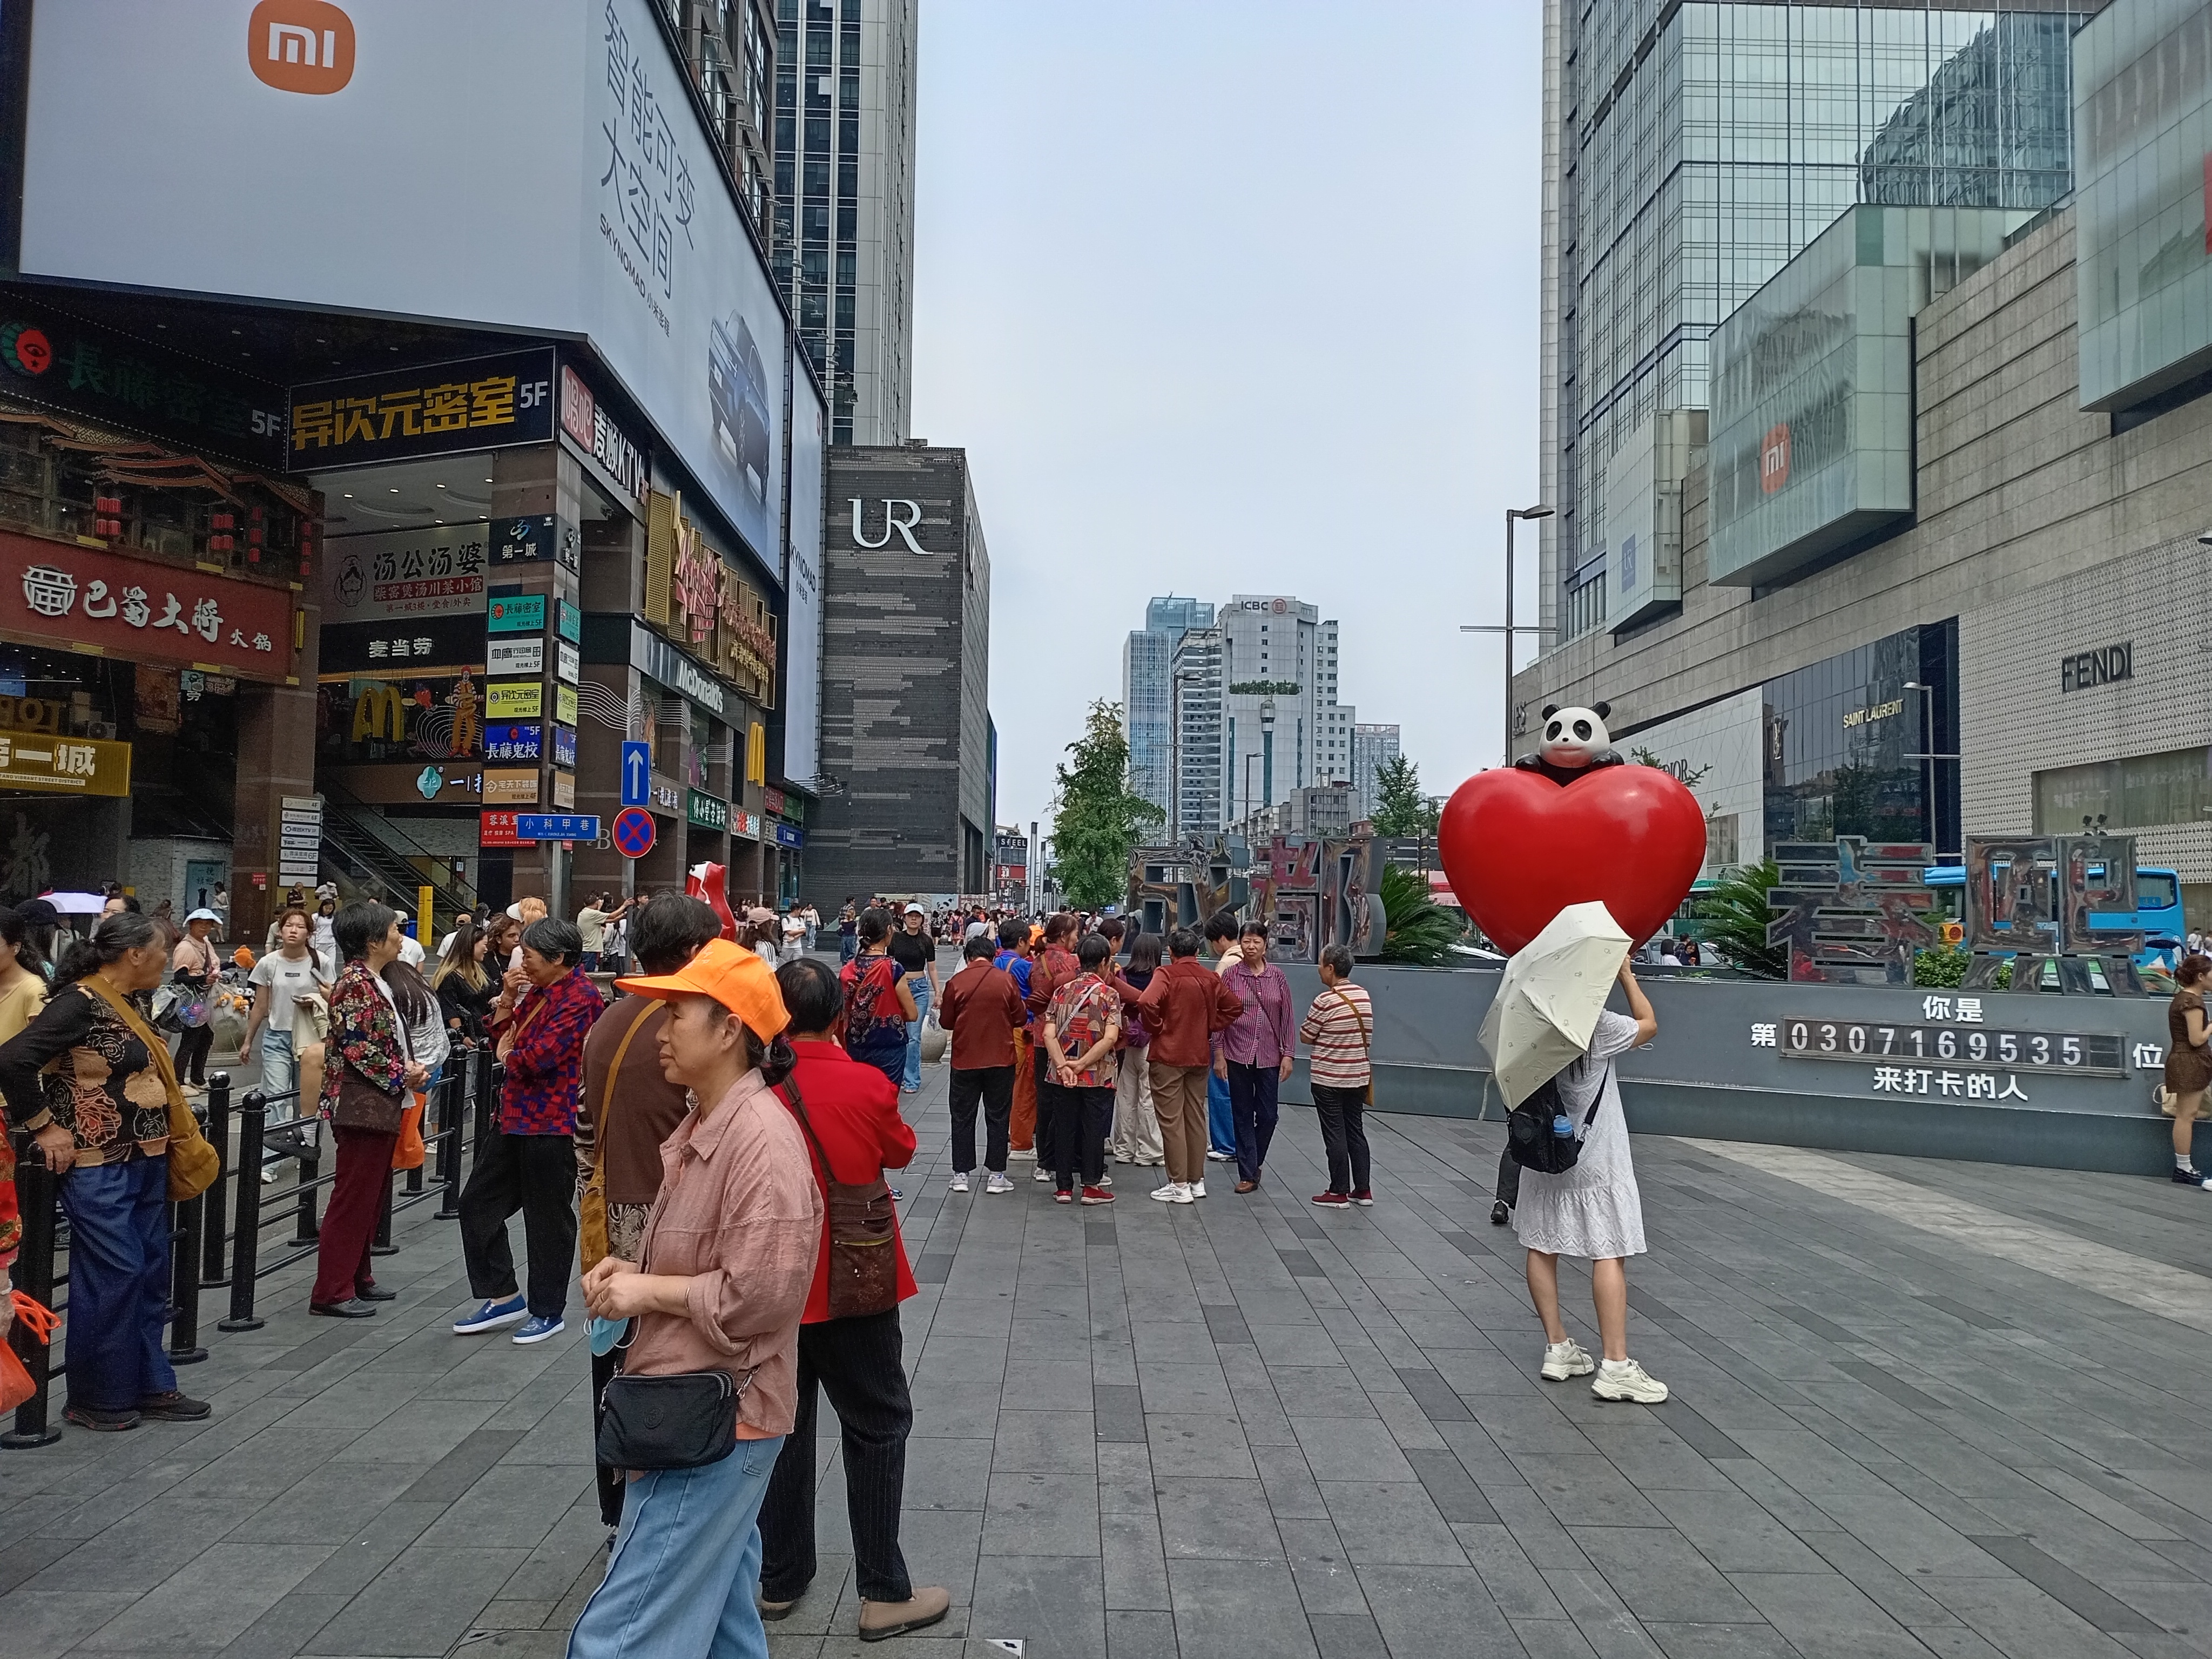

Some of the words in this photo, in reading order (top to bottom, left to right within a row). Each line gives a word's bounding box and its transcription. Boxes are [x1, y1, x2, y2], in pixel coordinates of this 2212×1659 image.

[605, 0, 695, 250] 智能可变
[602, 118, 672, 299] 大空间
[600, 213, 645, 298] SKYNOMAD
[251, 409, 281, 436] 5F
[292, 376, 516, 450] 异次元密室
[520, 381, 548, 408] 5F
[848, 499, 933, 554] UR
[373, 542, 485, 581] 汤公汤婆
[502, 543, 537, 559] 第一城
[84, 579, 224, 643] 巴蜀大将
[231, 629, 272, 652] 火锅
[1241, 601, 1268, 611] ICBC
[369, 637, 432, 658] 麦当劳
[2061, 643, 2134, 693] FENDI
[501, 689, 539, 700] 异次元密室
[675, 659, 723, 713] McDonald's
[1843, 710, 1864, 729] SAINT
[1866, 698, 1904, 723] LAURENT
[529, 726, 541, 736] 5F
[485, 742, 538, 759] 長藤鬼校
[525, 818, 589, 831] 小科甲巷
[595, 828, 611, 849] B
[1923, 996, 1984, 1023] 你是
[1750, 1023, 1777, 1048] 第
[1791, 1023, 2082, 1066] 0307169535
[2132, 1043, 2165, 1069] 位
[1873, 1067, 2029, 1102] 来打卡的人
